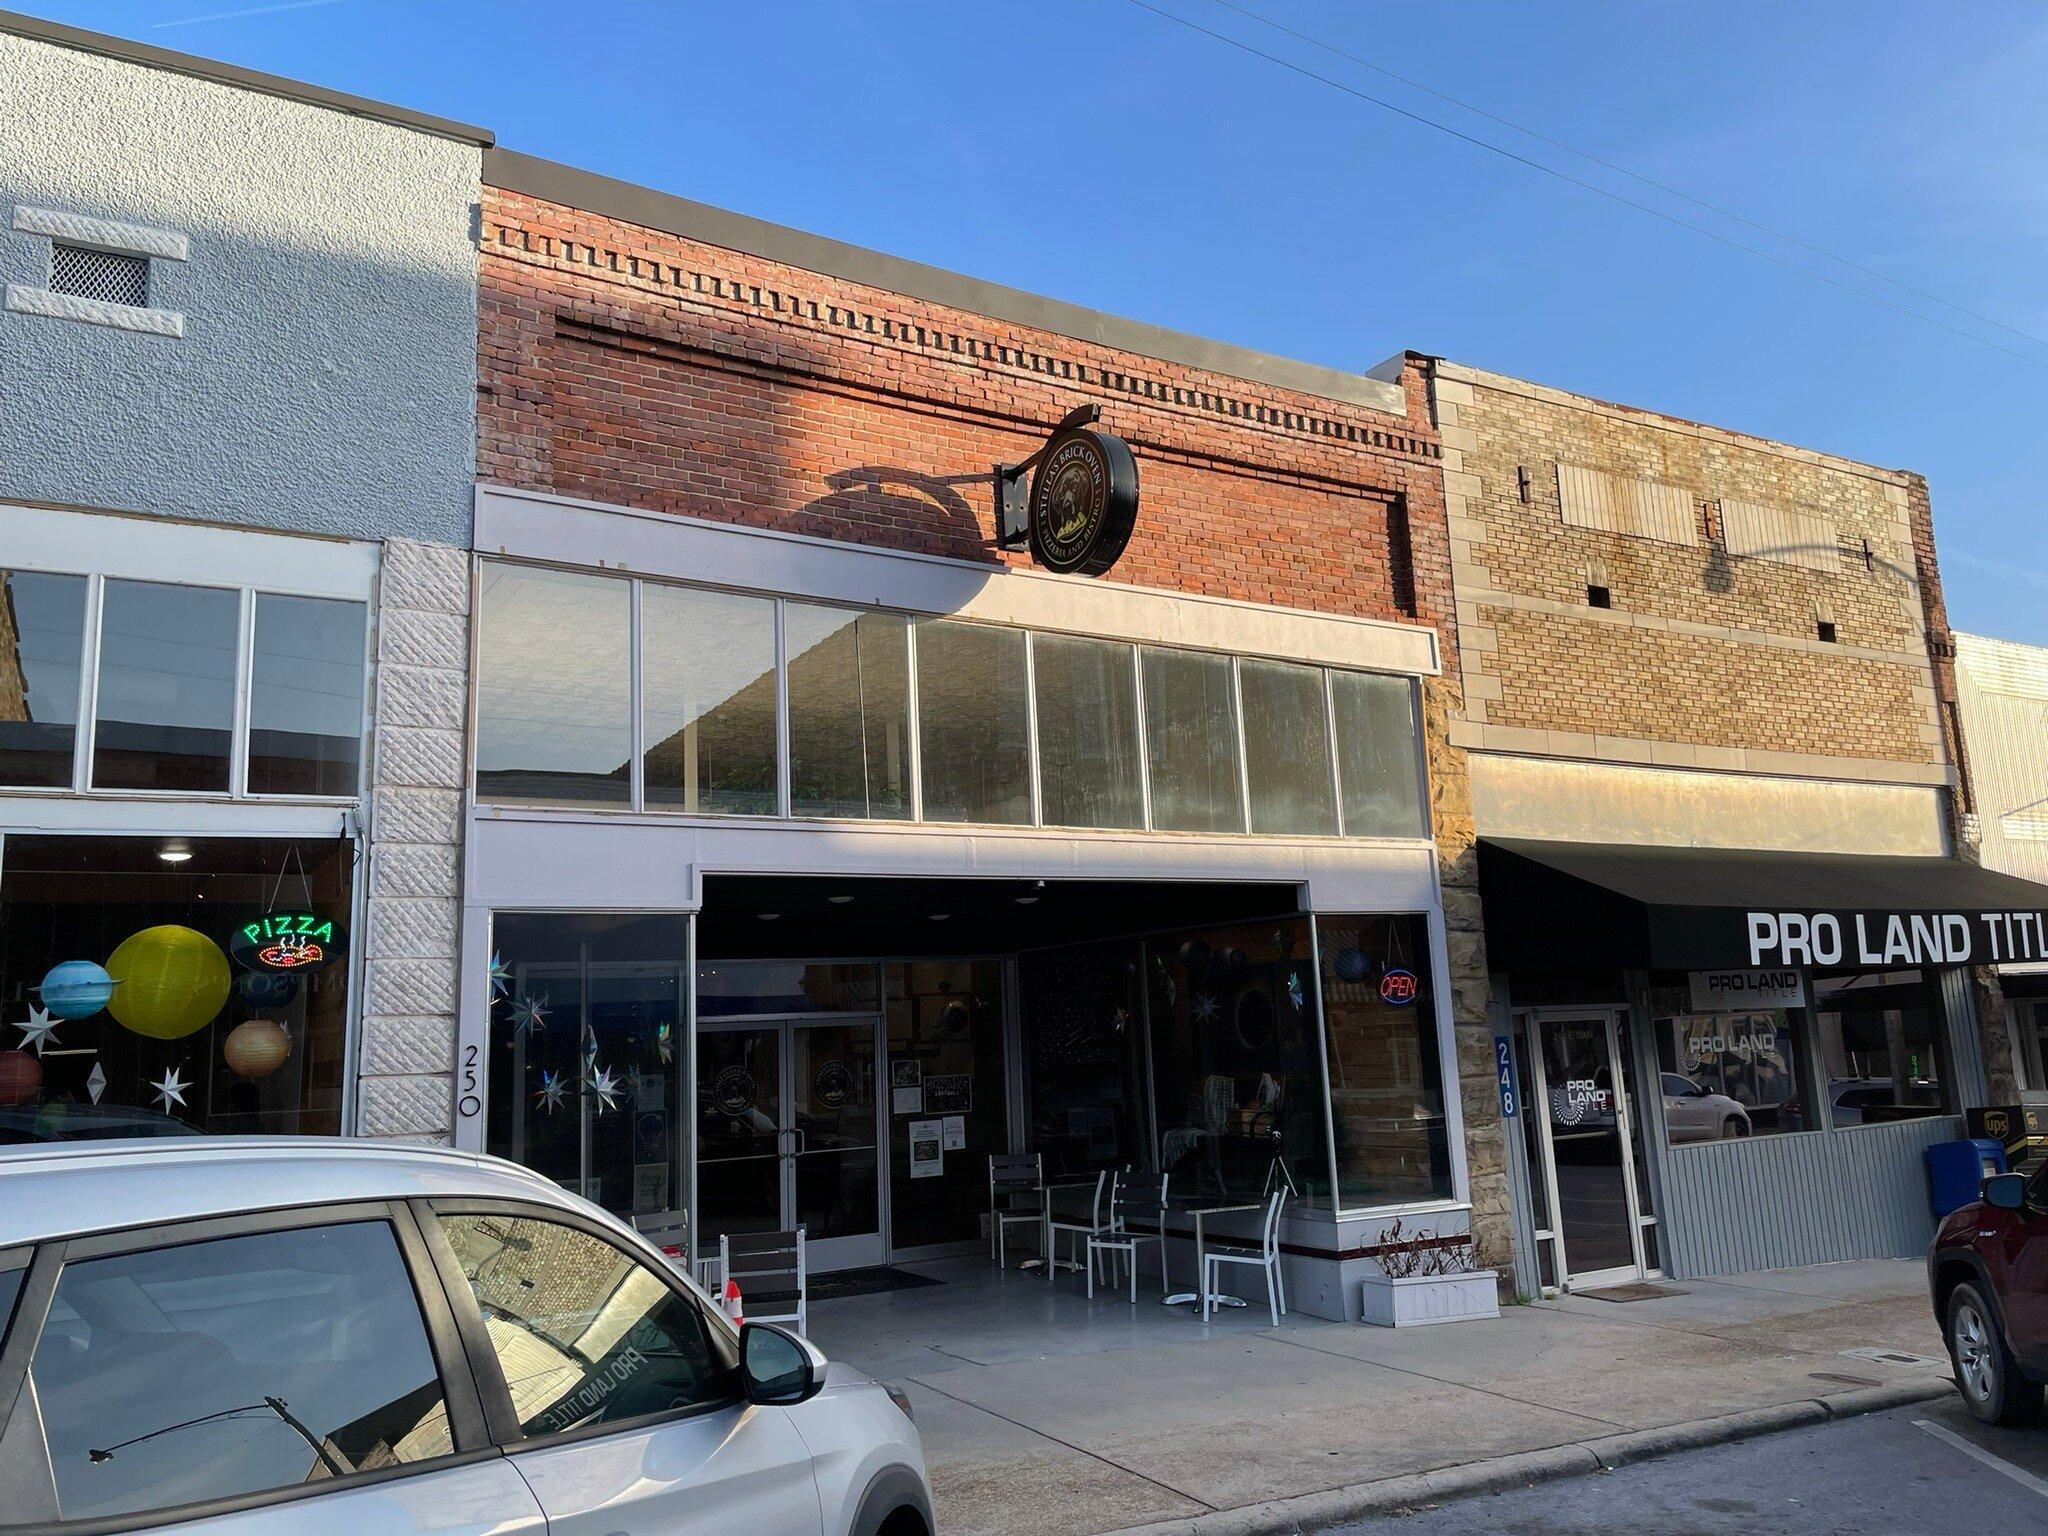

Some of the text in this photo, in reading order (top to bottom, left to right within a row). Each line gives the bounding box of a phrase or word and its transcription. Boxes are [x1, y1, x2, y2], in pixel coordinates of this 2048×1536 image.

[1039, 445, 1102, 516] STELLA'S BRICK OVEN
[1041, 527, 1067, 558] PIZZERIA
[1066, 539, 1085, 558] AND
[242, 915, 333, 944] PIZZA
[1747, 912, 2048, 966] PRO LAND TITL
[1380, 977, 1417, 996] OPEN
[1708, 972, 1798, 991] PRO LAND
[1757, 989, 1798, 998] TITLE
[1689, 1033, 1775, 1054] PRO LAND
[459, 1045, 482, 1117] 250
[1498, 1042, 1515, 1114] 248
[1566, 1079, 1596, 1092] PRO
[1568, 1090, 1606, 1104] LAND
[1987, 1118, 2008, 1136] ups
